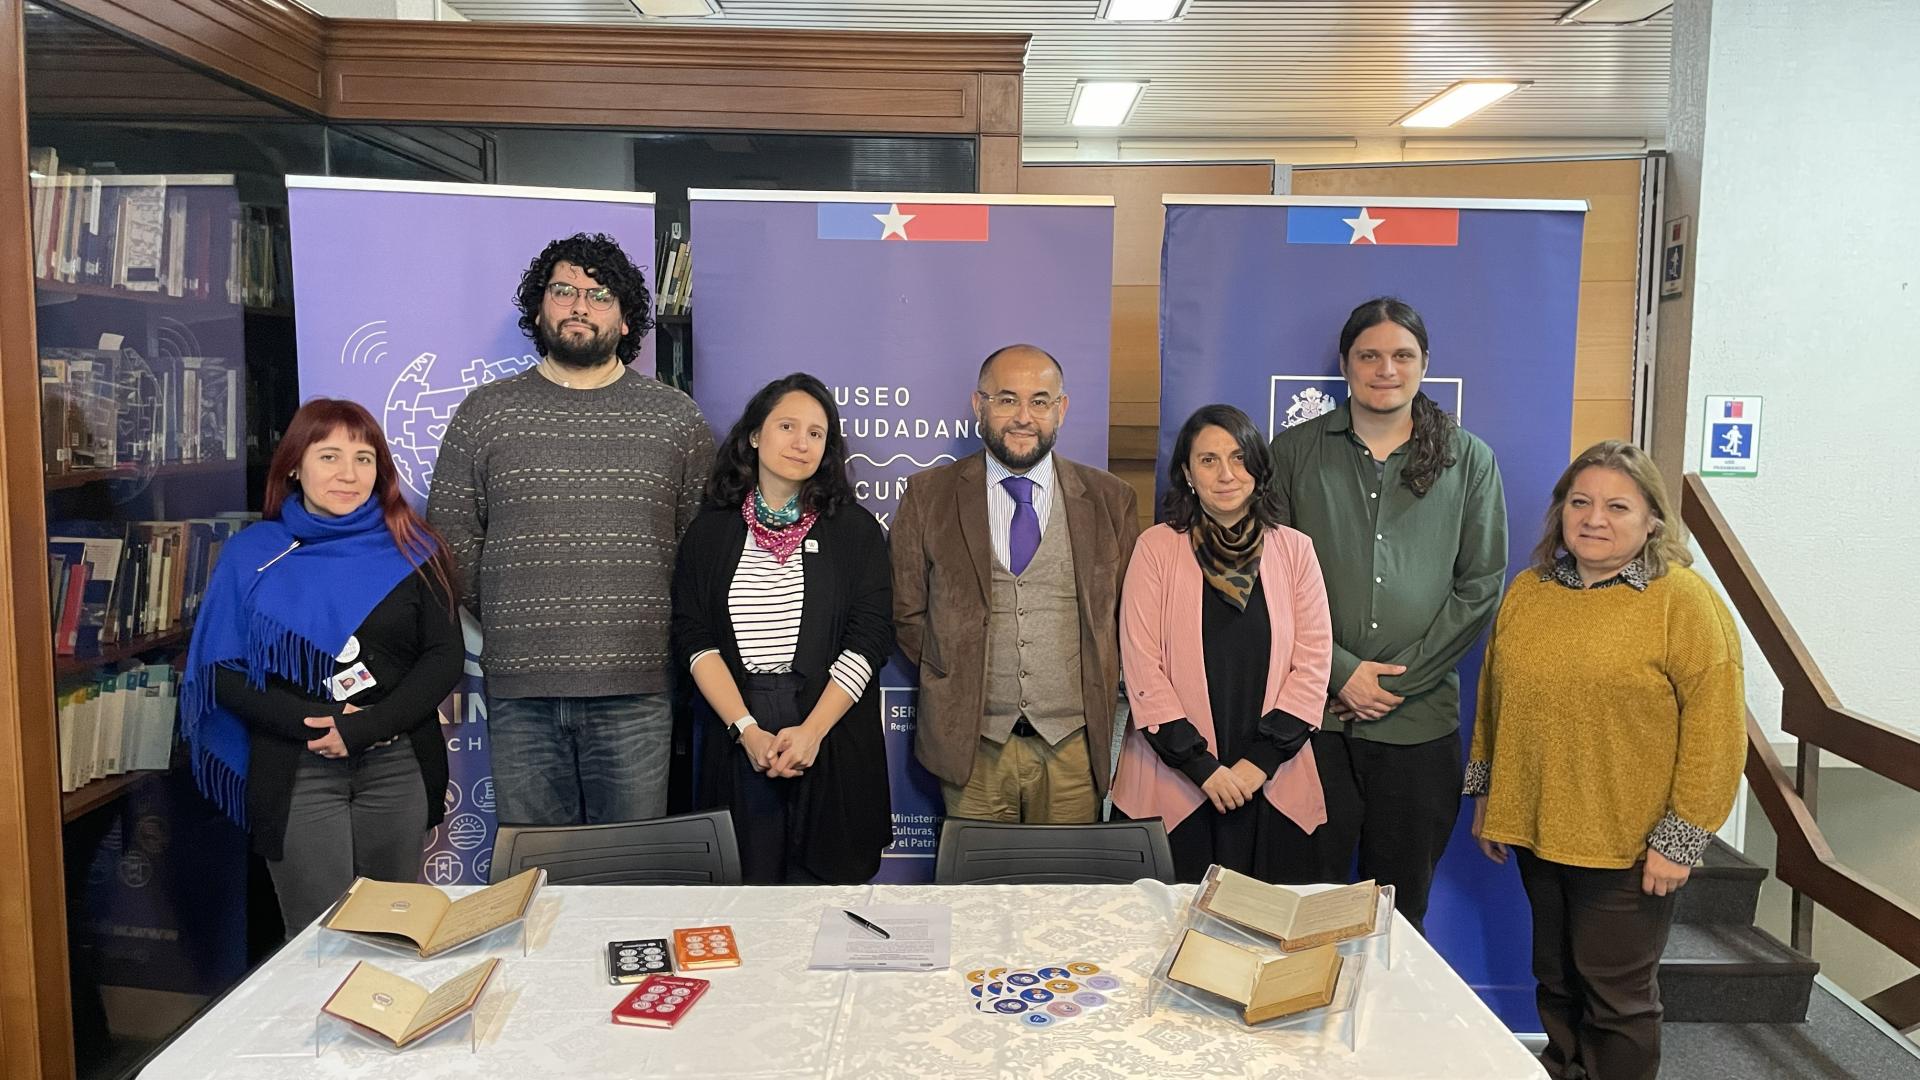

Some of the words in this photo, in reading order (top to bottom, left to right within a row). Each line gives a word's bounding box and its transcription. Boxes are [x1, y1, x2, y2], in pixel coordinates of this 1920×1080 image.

[826, 386, 910, 406] USEO
[891, 705, 916, 718] SER
[898, 838, 909, 848] el
[911, 838, 937, 848] Patri
